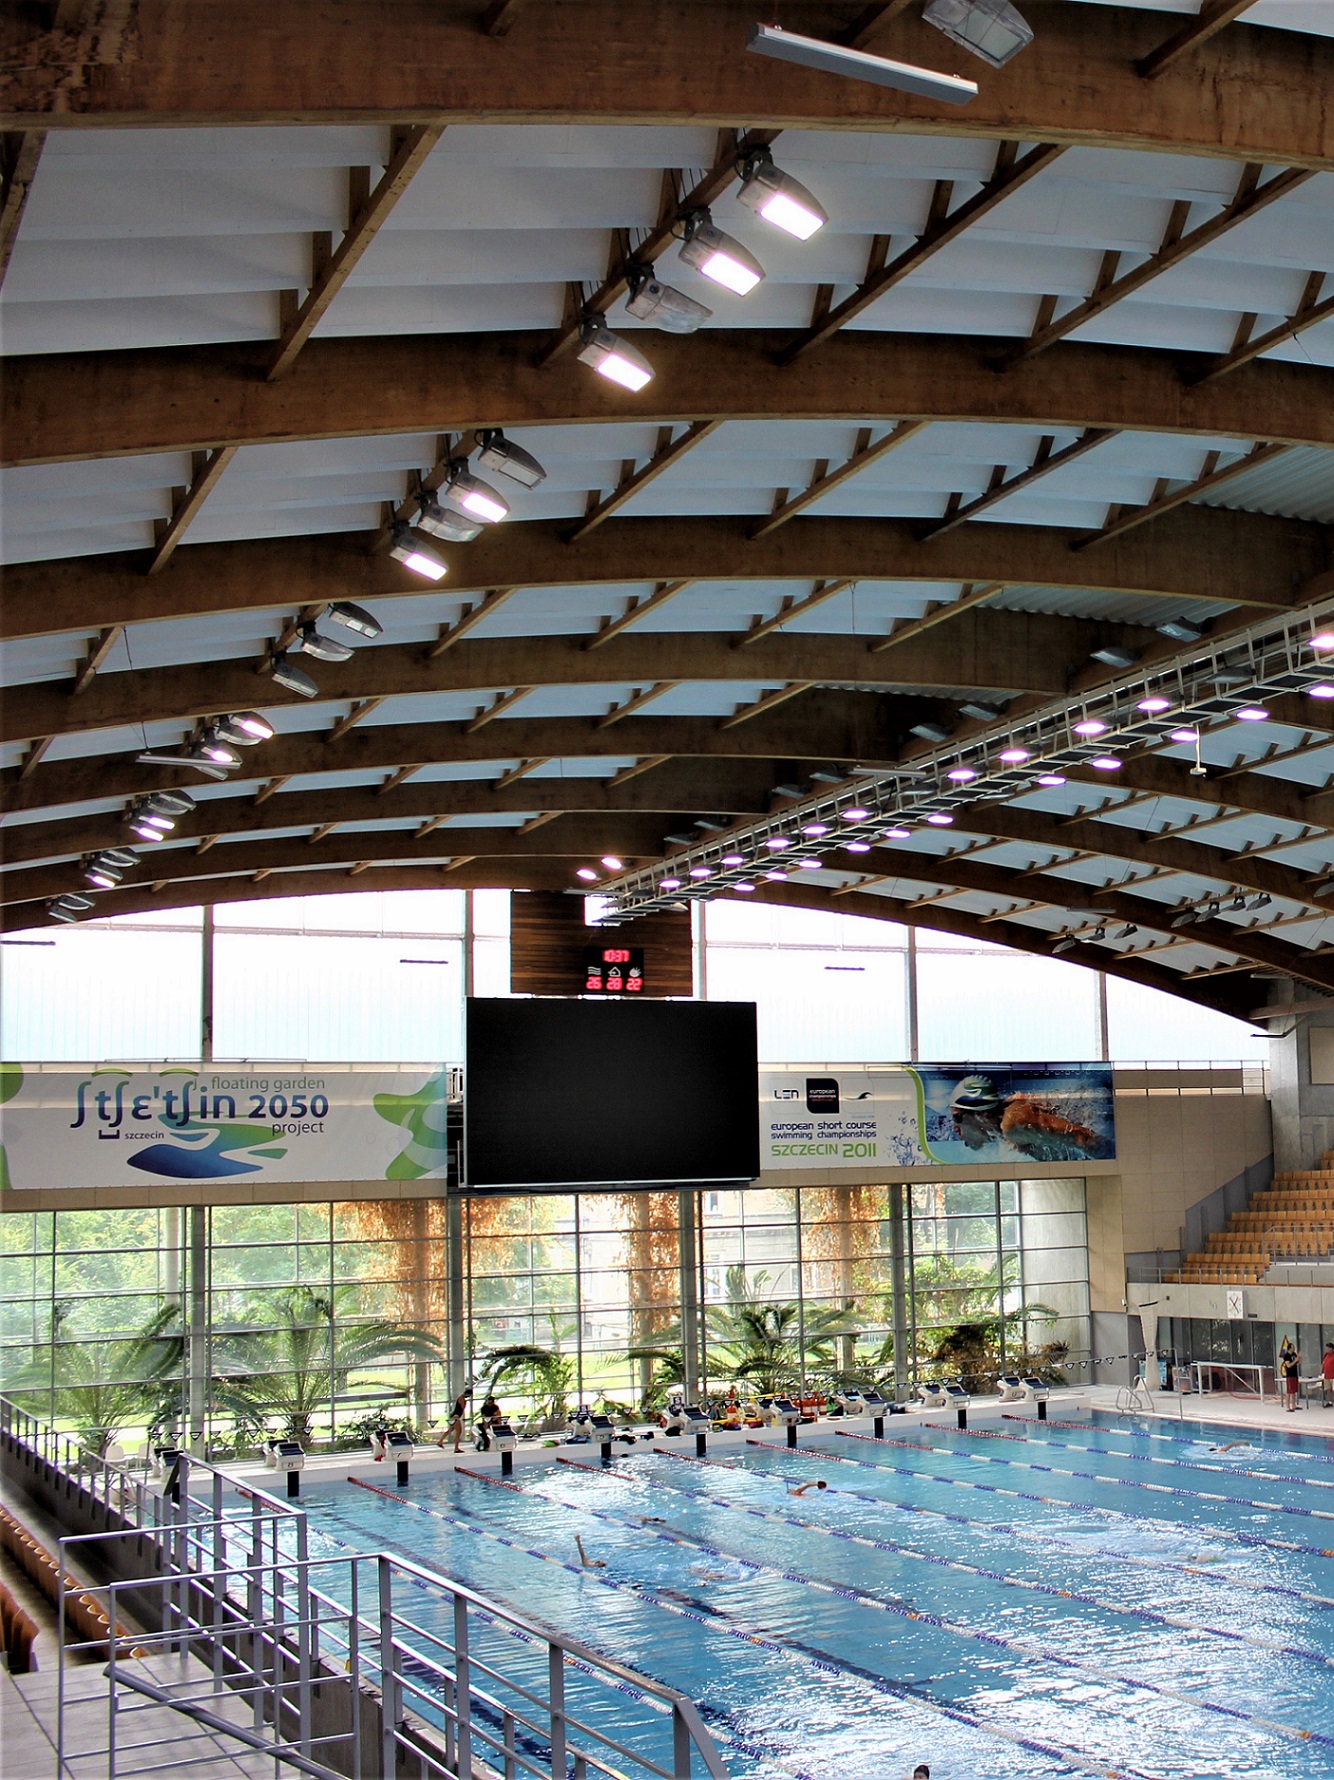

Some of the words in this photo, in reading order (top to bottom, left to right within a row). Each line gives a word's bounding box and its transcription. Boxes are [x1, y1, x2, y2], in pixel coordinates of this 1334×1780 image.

[606, 977, 622, 990] 28
[626, 977, 643, 991] 22
[212, 1076, 269, 1092] floating
[274, 1077, 325, 1092] garden
[248, 1094, 329, 1118] 2050
[272, 1121, 324, 1136] project
[771, 1123, 814, 1131] european
[818, 1121, 842, 1129] short
[124, 1131, 164, 1139] szczecin
[771, 1131, 813, 1140] swimming
[817, 1131, 876, 1139] championships
[771, 1144, 838, 1156] SZCZECIN
[843, 1143, 876, 1158] 2011
